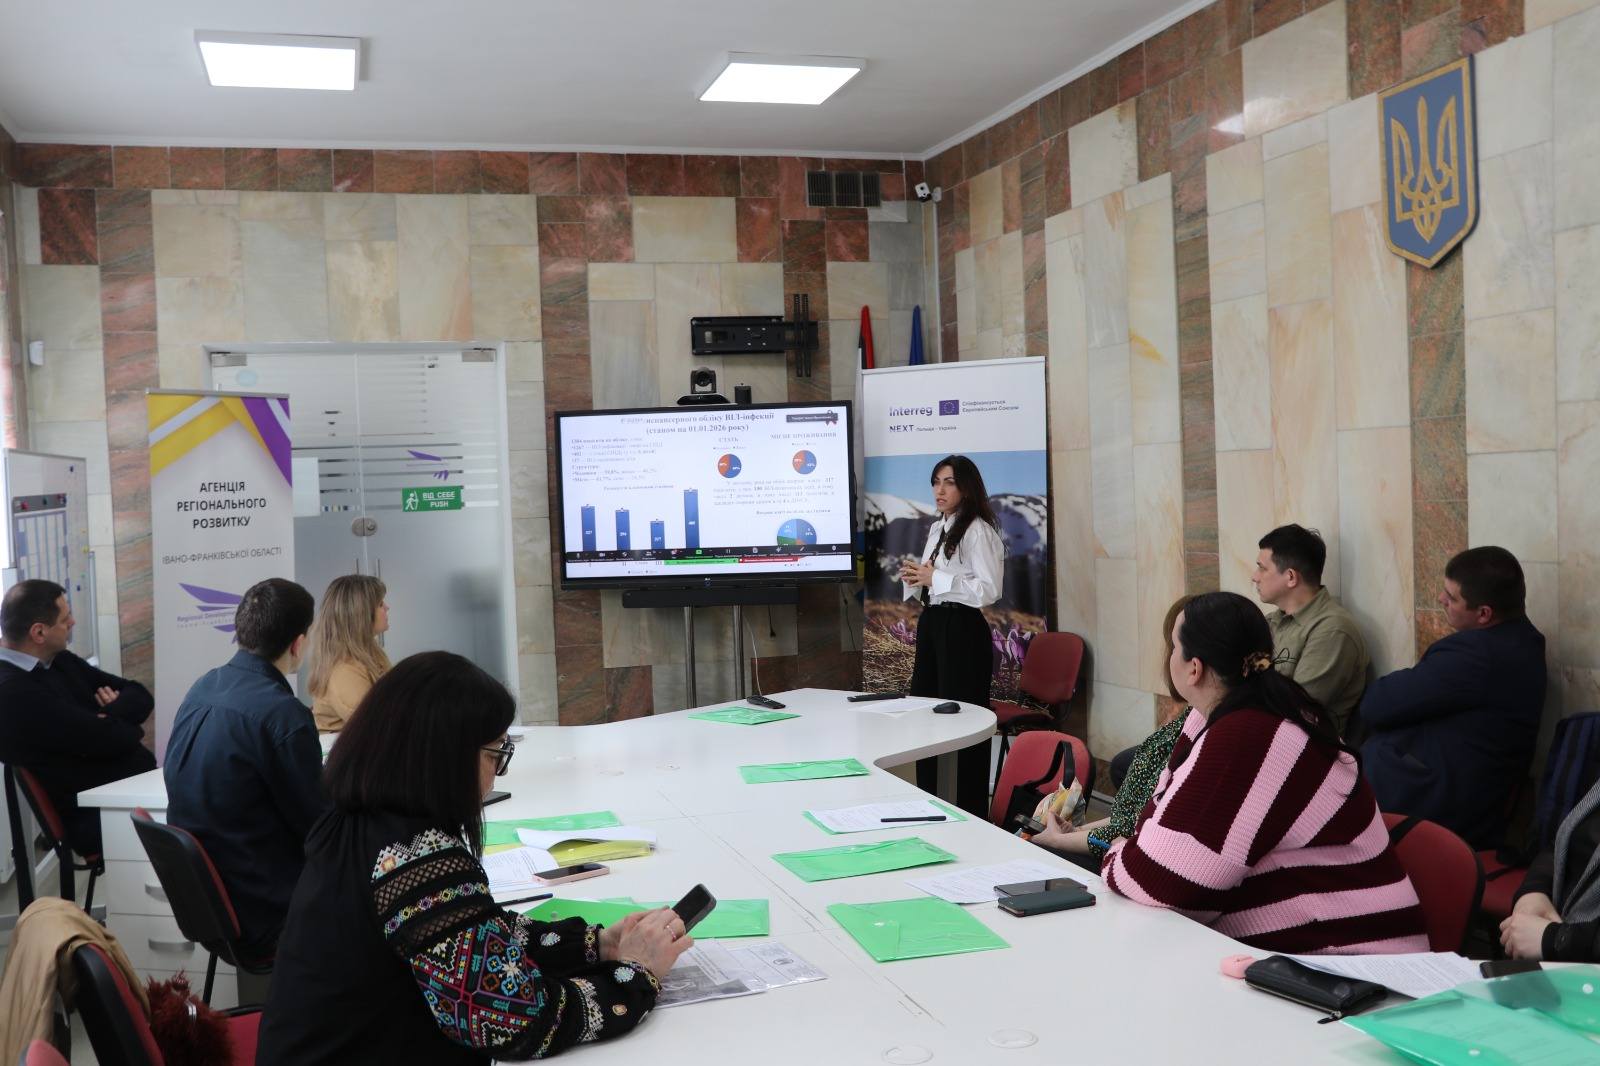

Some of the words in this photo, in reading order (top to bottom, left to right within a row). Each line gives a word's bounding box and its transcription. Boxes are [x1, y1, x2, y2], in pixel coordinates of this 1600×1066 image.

[889, 406, 933, 417] Interreg
[200, 481, 246, 494] АГЕНЦІЯ
[177, 498, 267, 512] РЕГІОНАЛЬНОГО
[430, 500, 449, 508] PUSH
[193, 516, 251, 529] РОЗВИТКУ
[162, 549, 249, 565] ІВАНО-ФРАНКІВСЬКОЇ
[250, 546, 282, 558] ОБЛАСТІ
